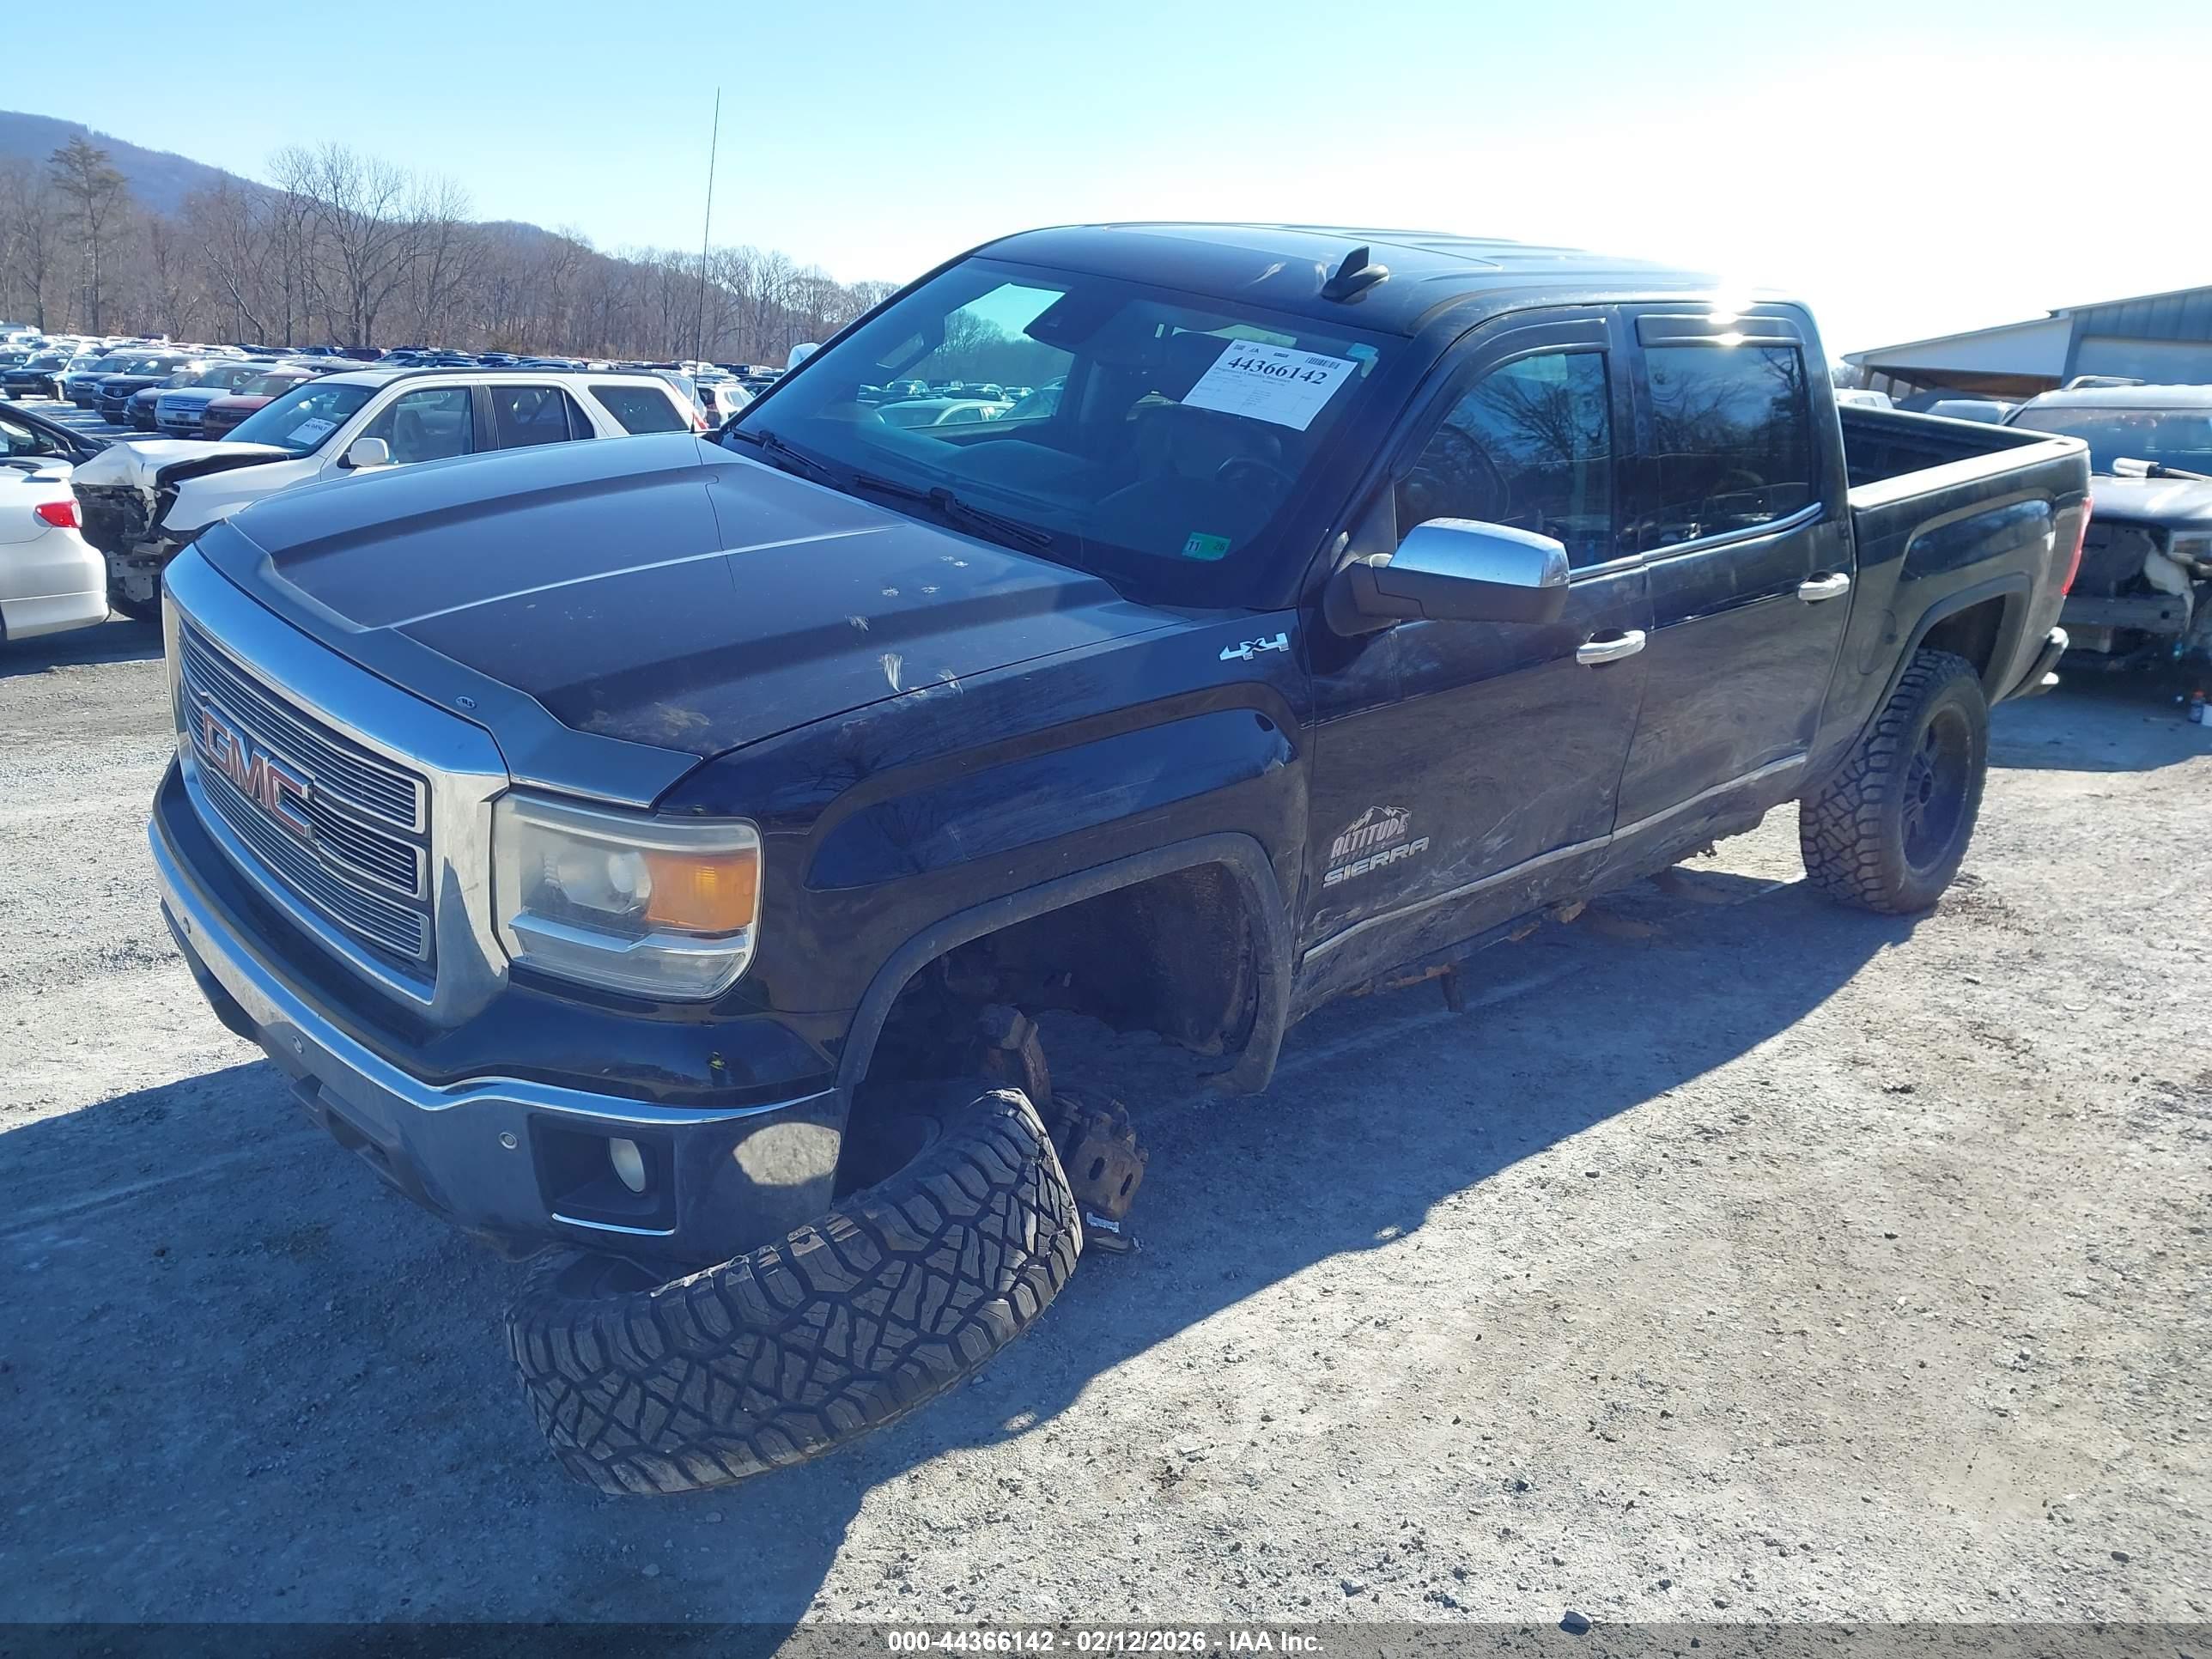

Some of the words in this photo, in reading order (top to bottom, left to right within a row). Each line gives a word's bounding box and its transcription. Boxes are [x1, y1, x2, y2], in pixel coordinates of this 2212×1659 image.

[1227, 356, 1328, 385] 44366142
[1188, 540, 1201, 551] 11
[202, 704, 317, 841] GMC
[1330, 813, 1411, 860] ALTITUDE
[1322, 836, 1430, 889] SIERRA
